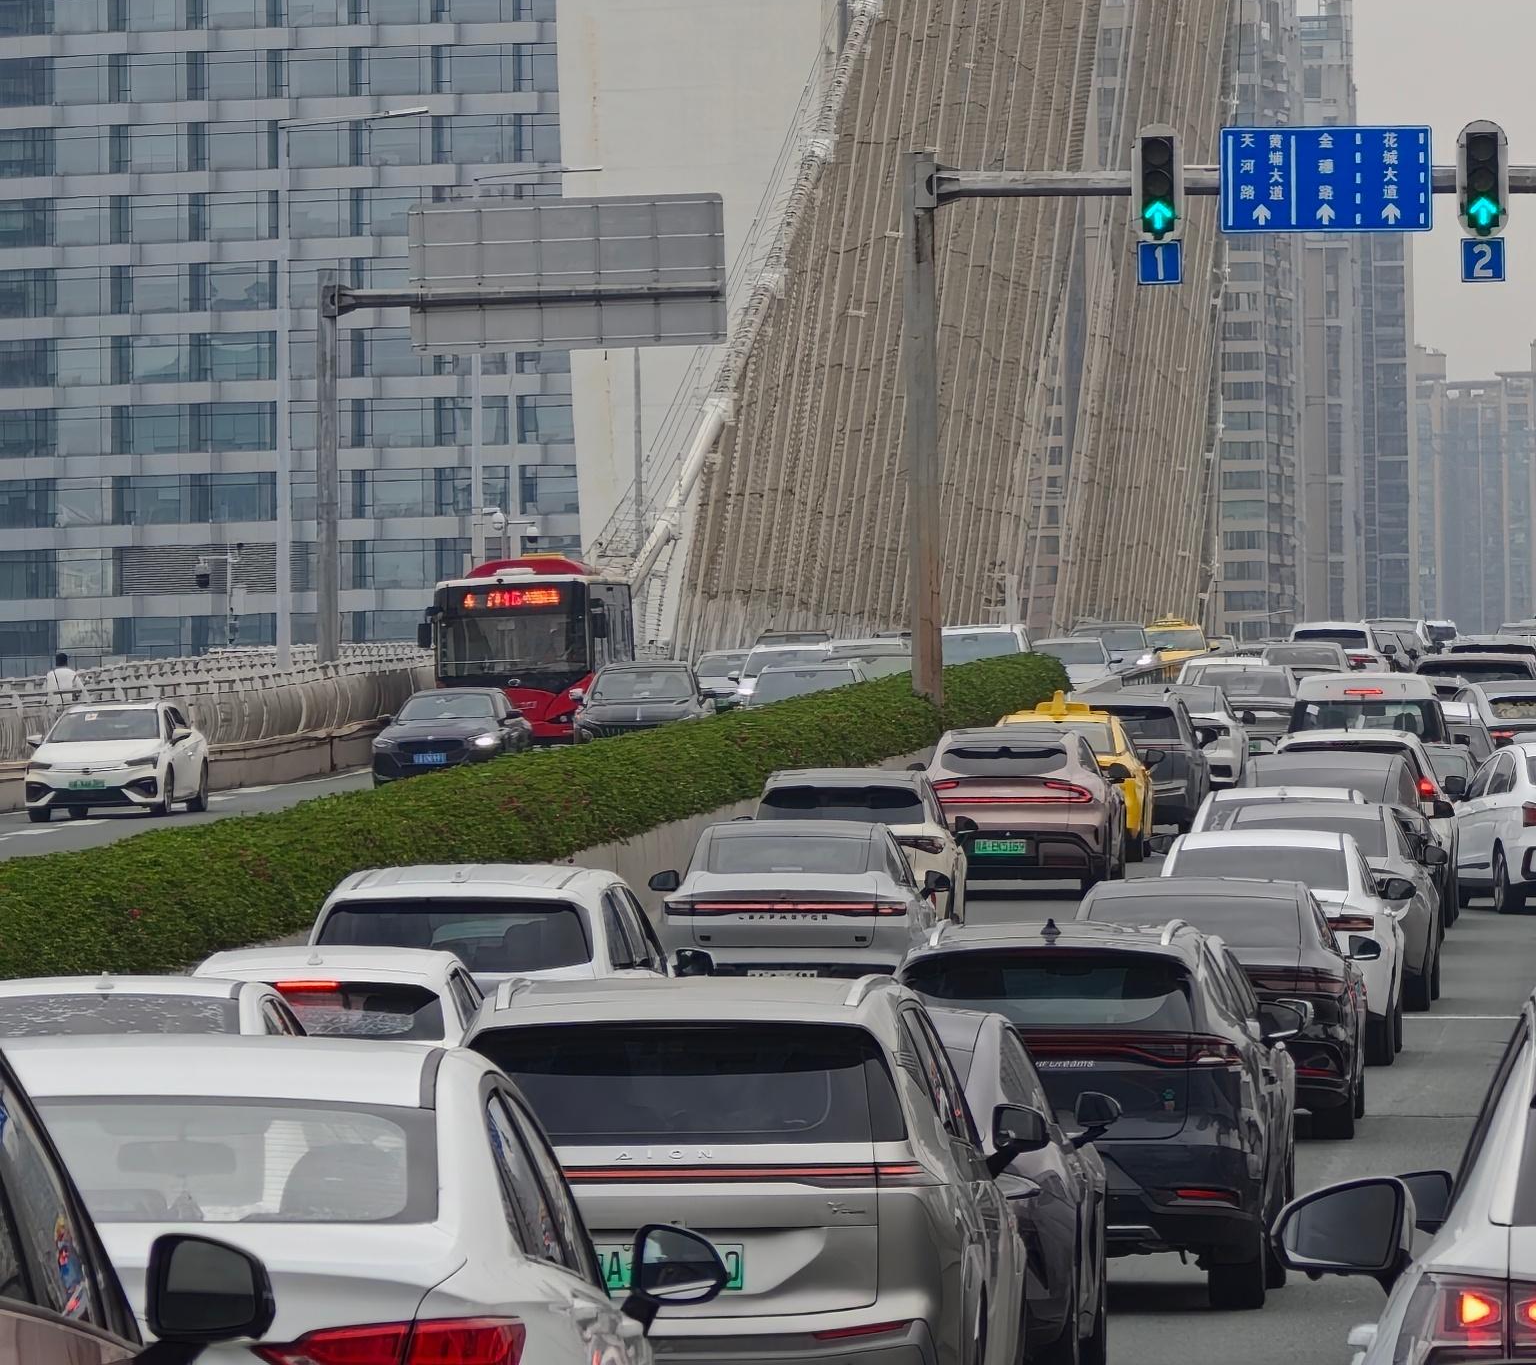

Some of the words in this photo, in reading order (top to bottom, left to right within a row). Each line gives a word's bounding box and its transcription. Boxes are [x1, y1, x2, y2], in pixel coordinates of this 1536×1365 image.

[1240, 133, 1255, 200] 天河路
[1268, 134, 1284, 201] 黄埔大道
[1383, 132, 1399, 199] 花城大道
[1153, 247, 1165, 280] 1
[1473, 243, 1494, 277] 2
[615, 1149, 713, 1160] AION
